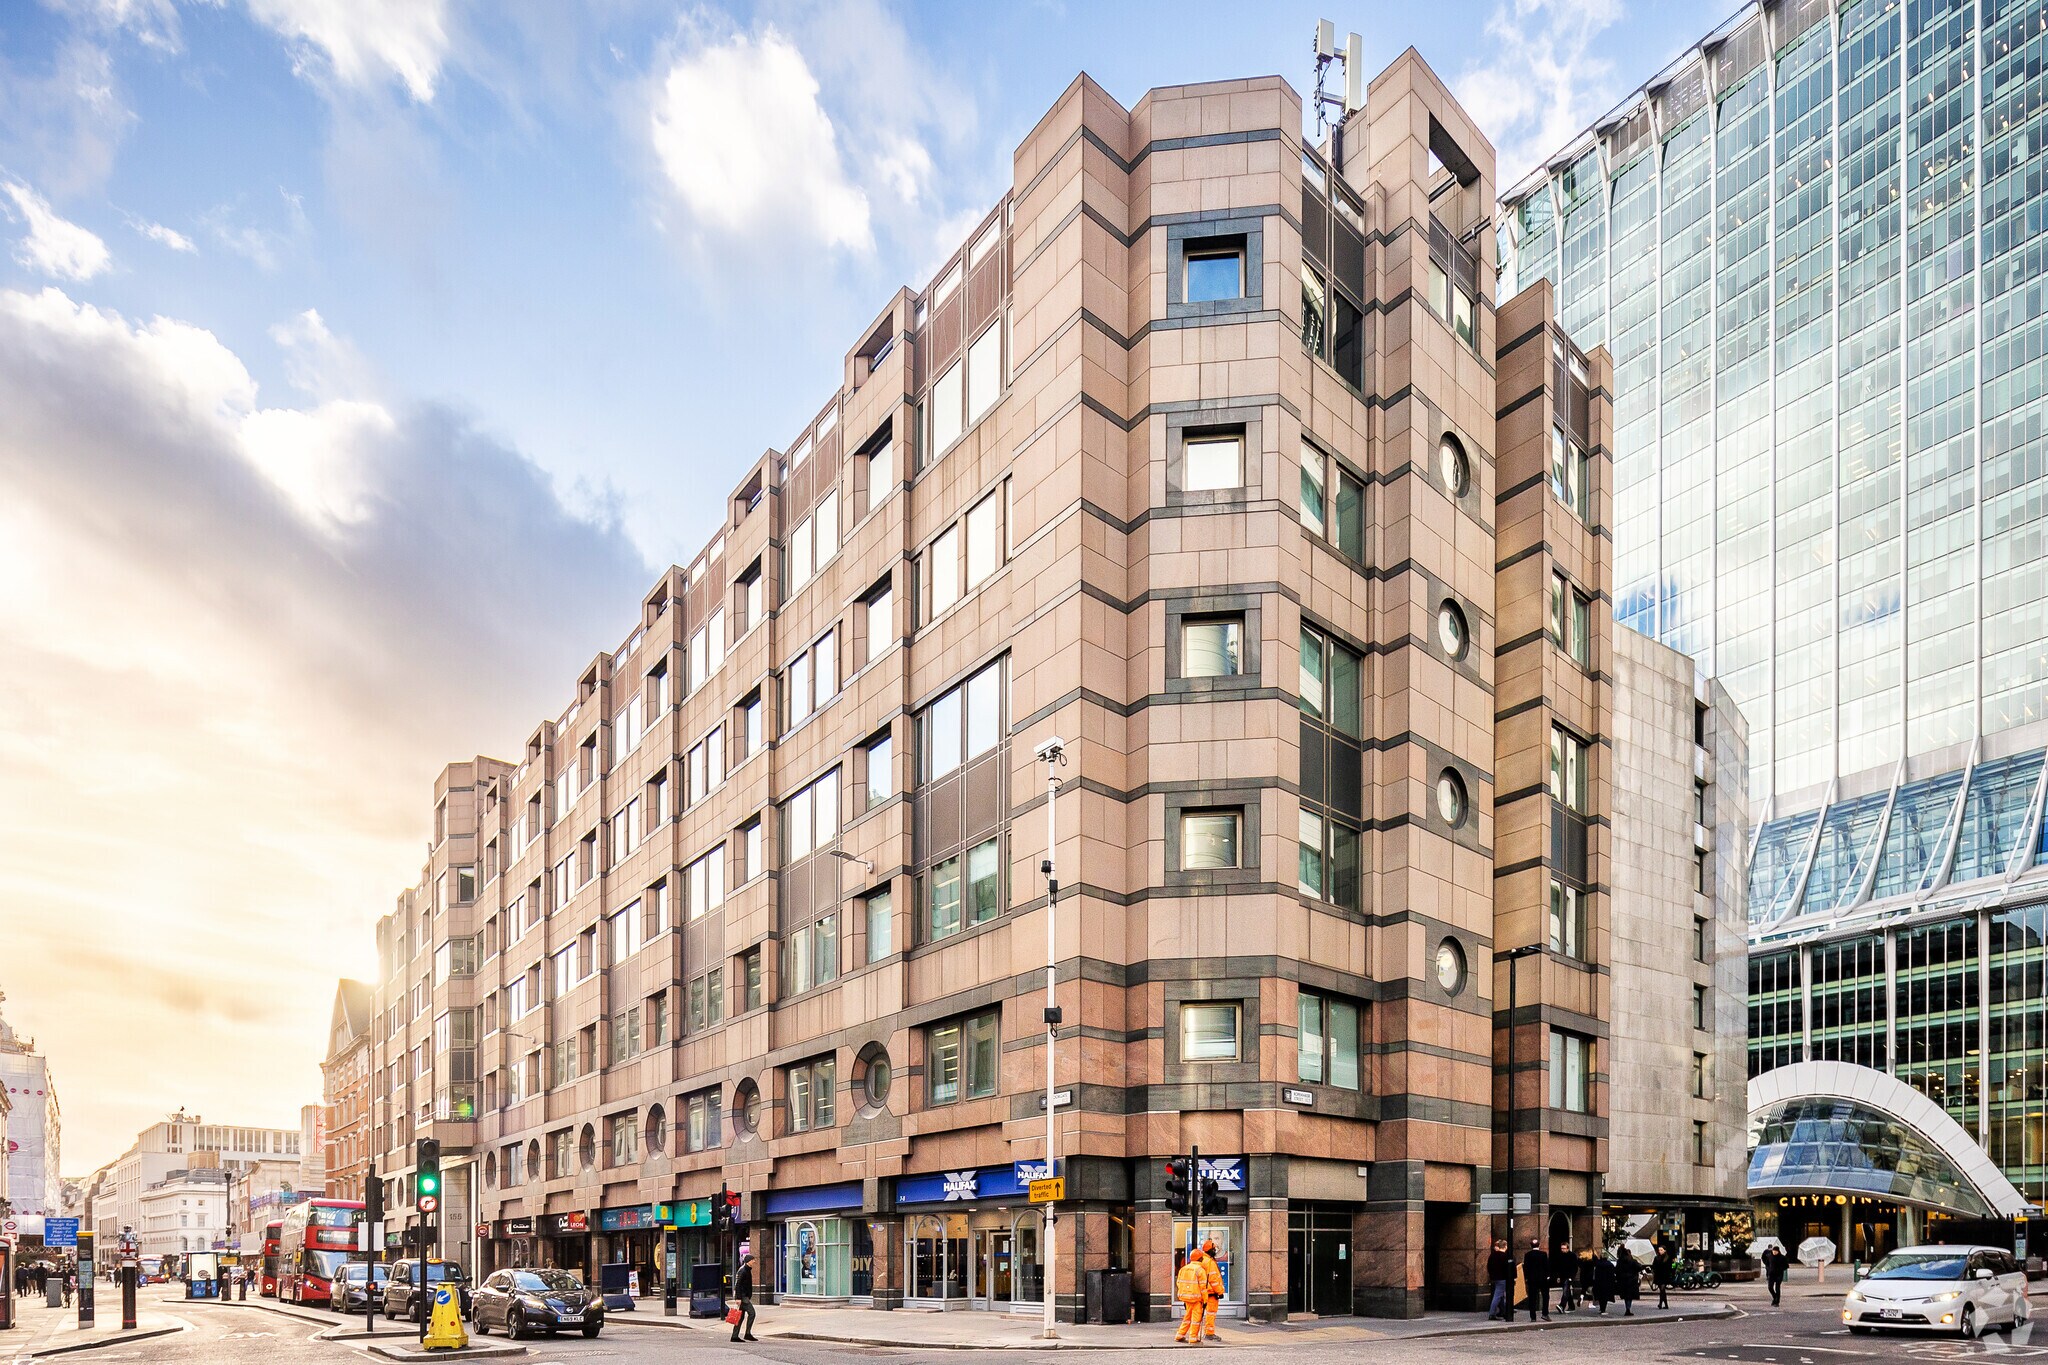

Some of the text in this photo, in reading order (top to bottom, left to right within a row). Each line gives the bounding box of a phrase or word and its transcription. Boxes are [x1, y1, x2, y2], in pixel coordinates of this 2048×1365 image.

[943, 1180, 977, 1192] HALIFAX
[1031, 1183, 1052, 1192] Diverted
[1779, 1194, 1882, 1207] CITYPOIN
[851, 1257, 873, 1272] DIY
